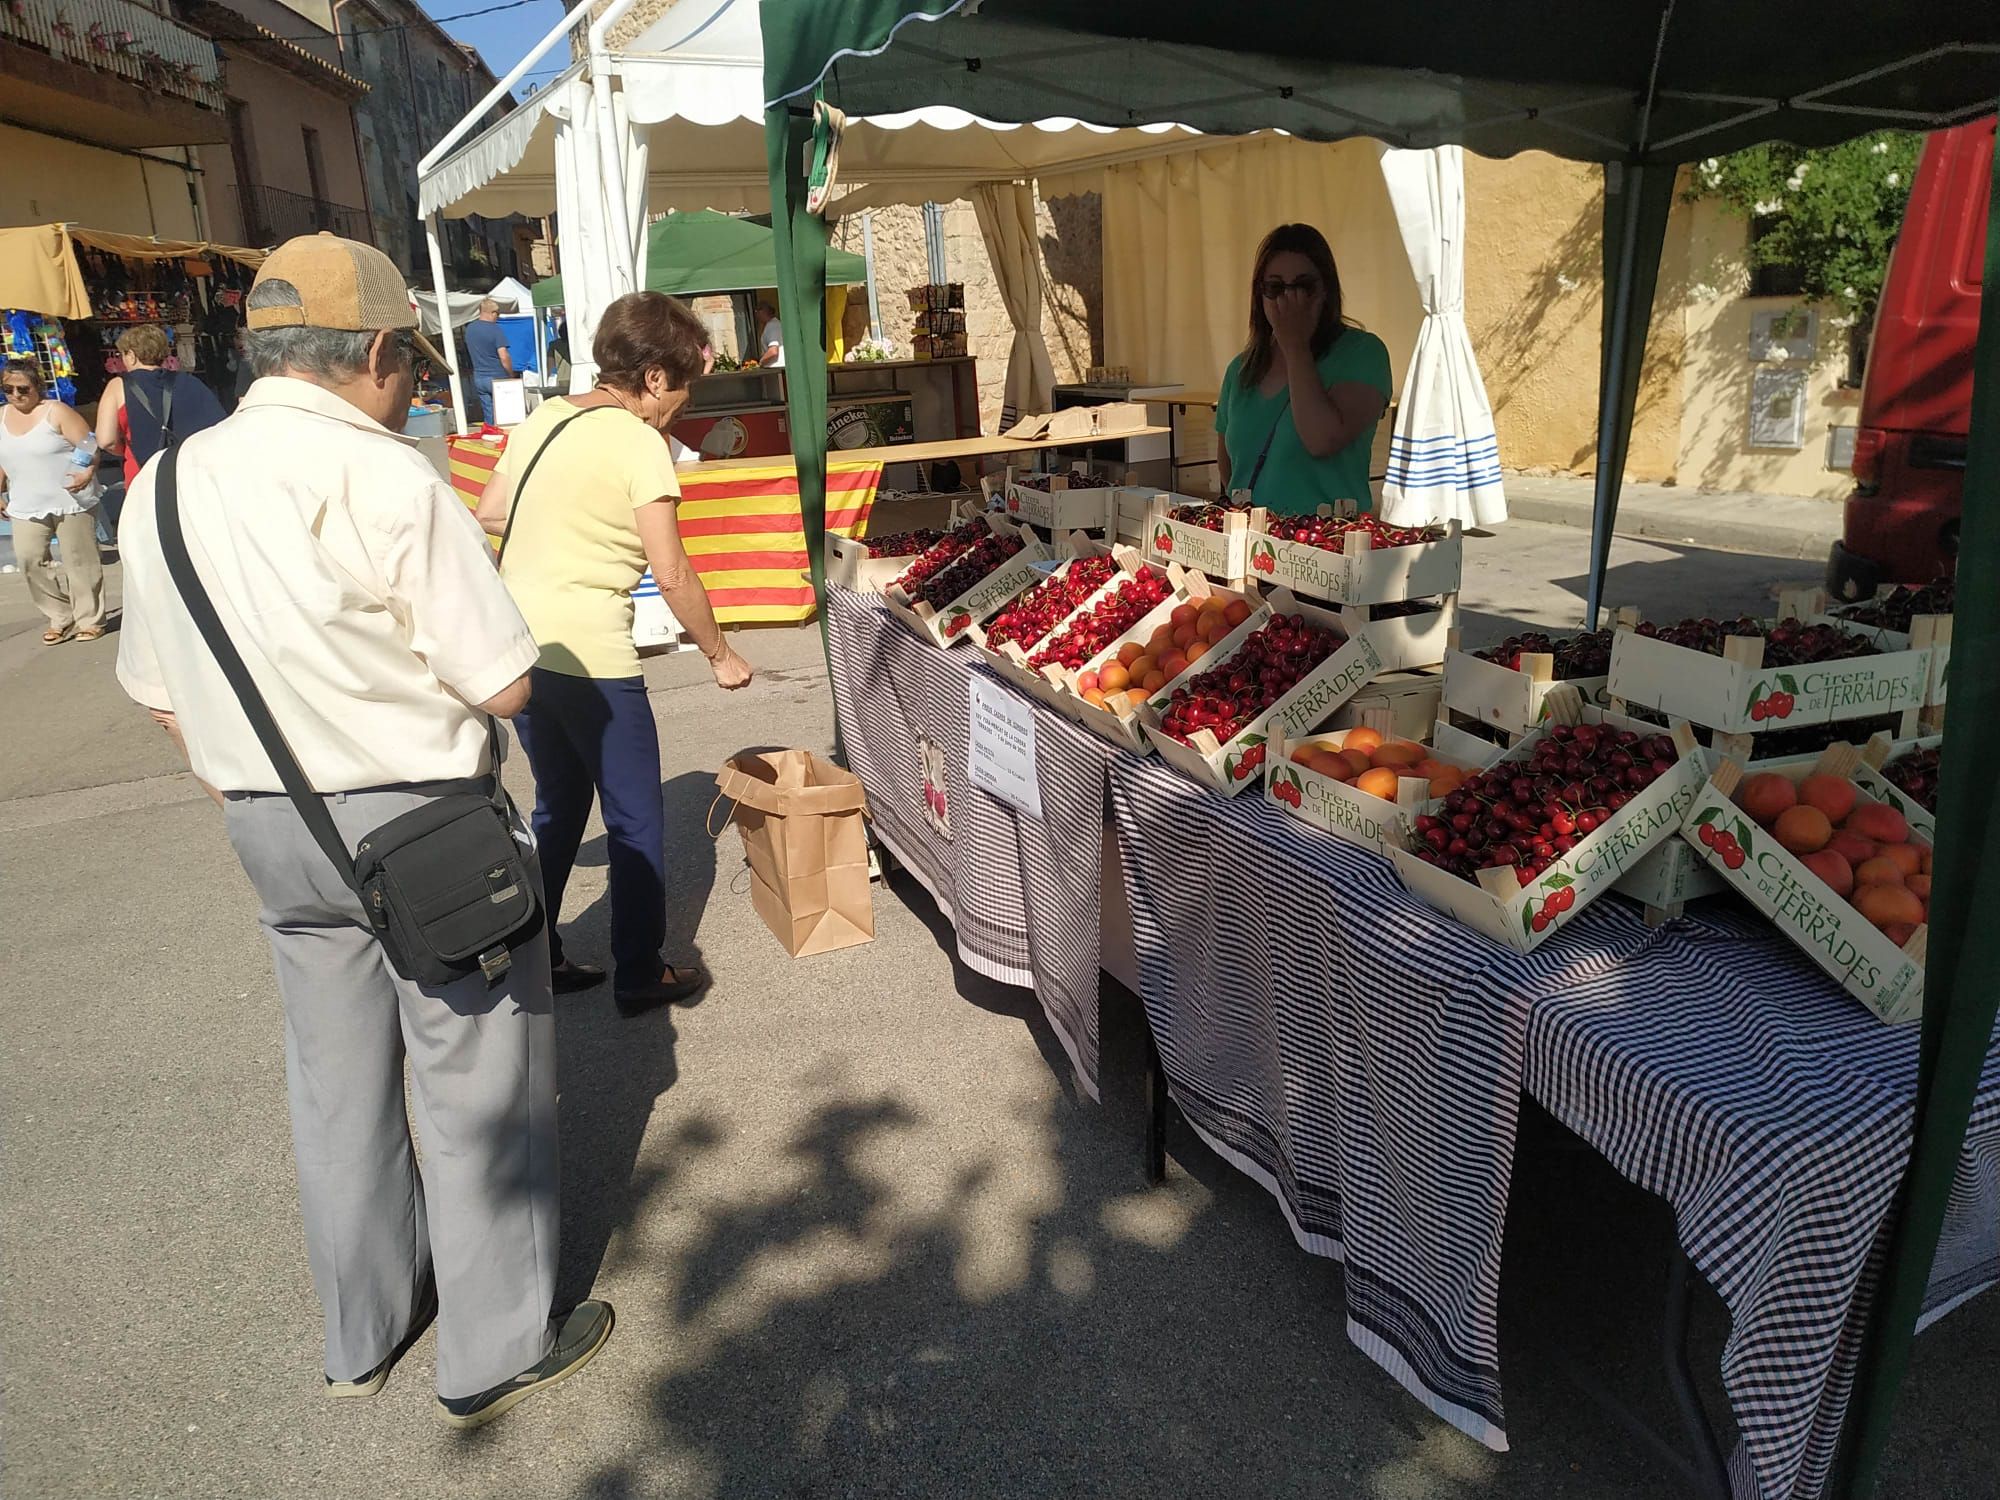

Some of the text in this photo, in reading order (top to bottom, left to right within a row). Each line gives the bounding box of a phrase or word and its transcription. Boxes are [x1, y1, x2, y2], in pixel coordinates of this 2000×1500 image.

[827, 411, 869, 435] eineken
[1020, 492, 1040, 504] Cirera
[1026, 502, 1050, 520] TERRADES
[1174, 530, 1205, 547] Cirera
[1184, 542, 1220, 568] TERRADES
[1278, 548, 1319, 568] Cirera
[967, 572, 1012, 608] Cirera
[978, 565, 1035, 613] DE TERRADE
[1282, 567, 1290, 576] DE
[1289, 562, 1340, 592] TERRADES
[1286, 658, 1365, 730] TERRADES
[1803, 670, 1874, 694] Cirera
[1808, 698, 1822, 710] DE
[1823, 676, 1908, 709] TERRADES
[1305, 780, 1360, 813] Cirera
[1312, 804, 1321, 816] DE
[1321, 799, 1384, 843] TERRADE
[1590, 865, 1604, 882] DE
[1600, 784, 1692, 870] TERRADES
[1574, 807, 1649, 875] Cirera
[1757, 852, 1842, 931] Cirera
[1757, 878, 1775, 897] DE
[1773, 880, 1881, 989] TERRADES
